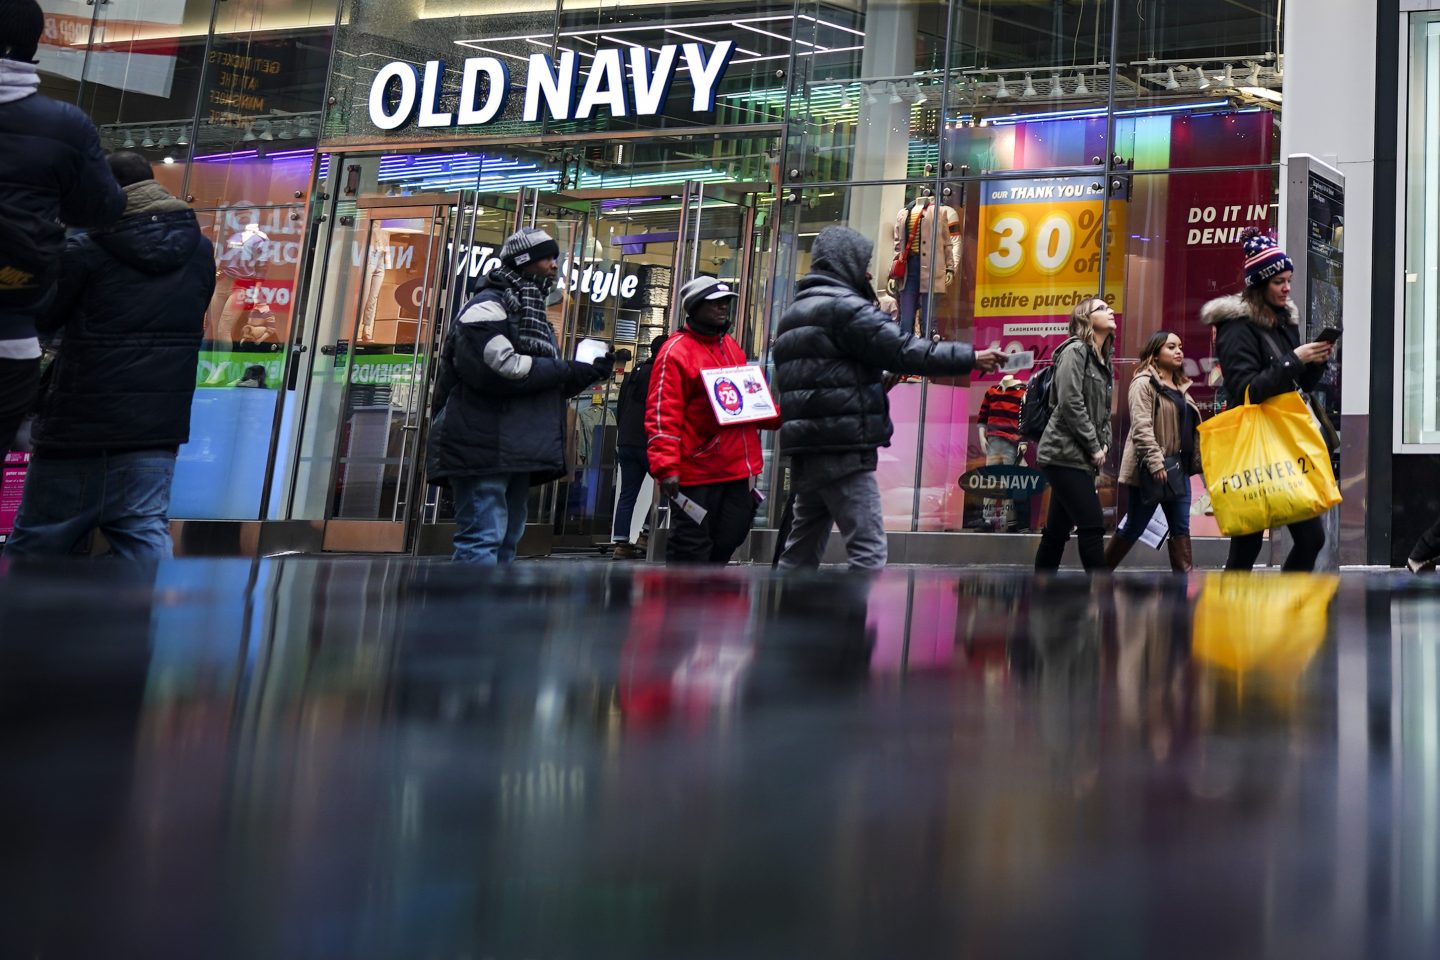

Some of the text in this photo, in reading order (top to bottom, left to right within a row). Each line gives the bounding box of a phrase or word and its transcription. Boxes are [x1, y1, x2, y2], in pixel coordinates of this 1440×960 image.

[369, 41, 736, 130] OLD NAVY
[991, 190, 1008, 200] OUR
[1010, 186, 1055, 200] THANK
[1058, 184, 1085, 199] YOU
[1187, 204, 1268, 224] DO IT IN
[1073, 251, 1111, 273] off
[1258, 259, 1285, 280] NEW
[556, 259, 639, 303] Style
[980, 291, 1030, 309] entire
[718, 389, 738, 405] $29
[968, 474, 1041, 490] OLD NAVY
[1221, 454, 1316, 494] FOREVER 21
